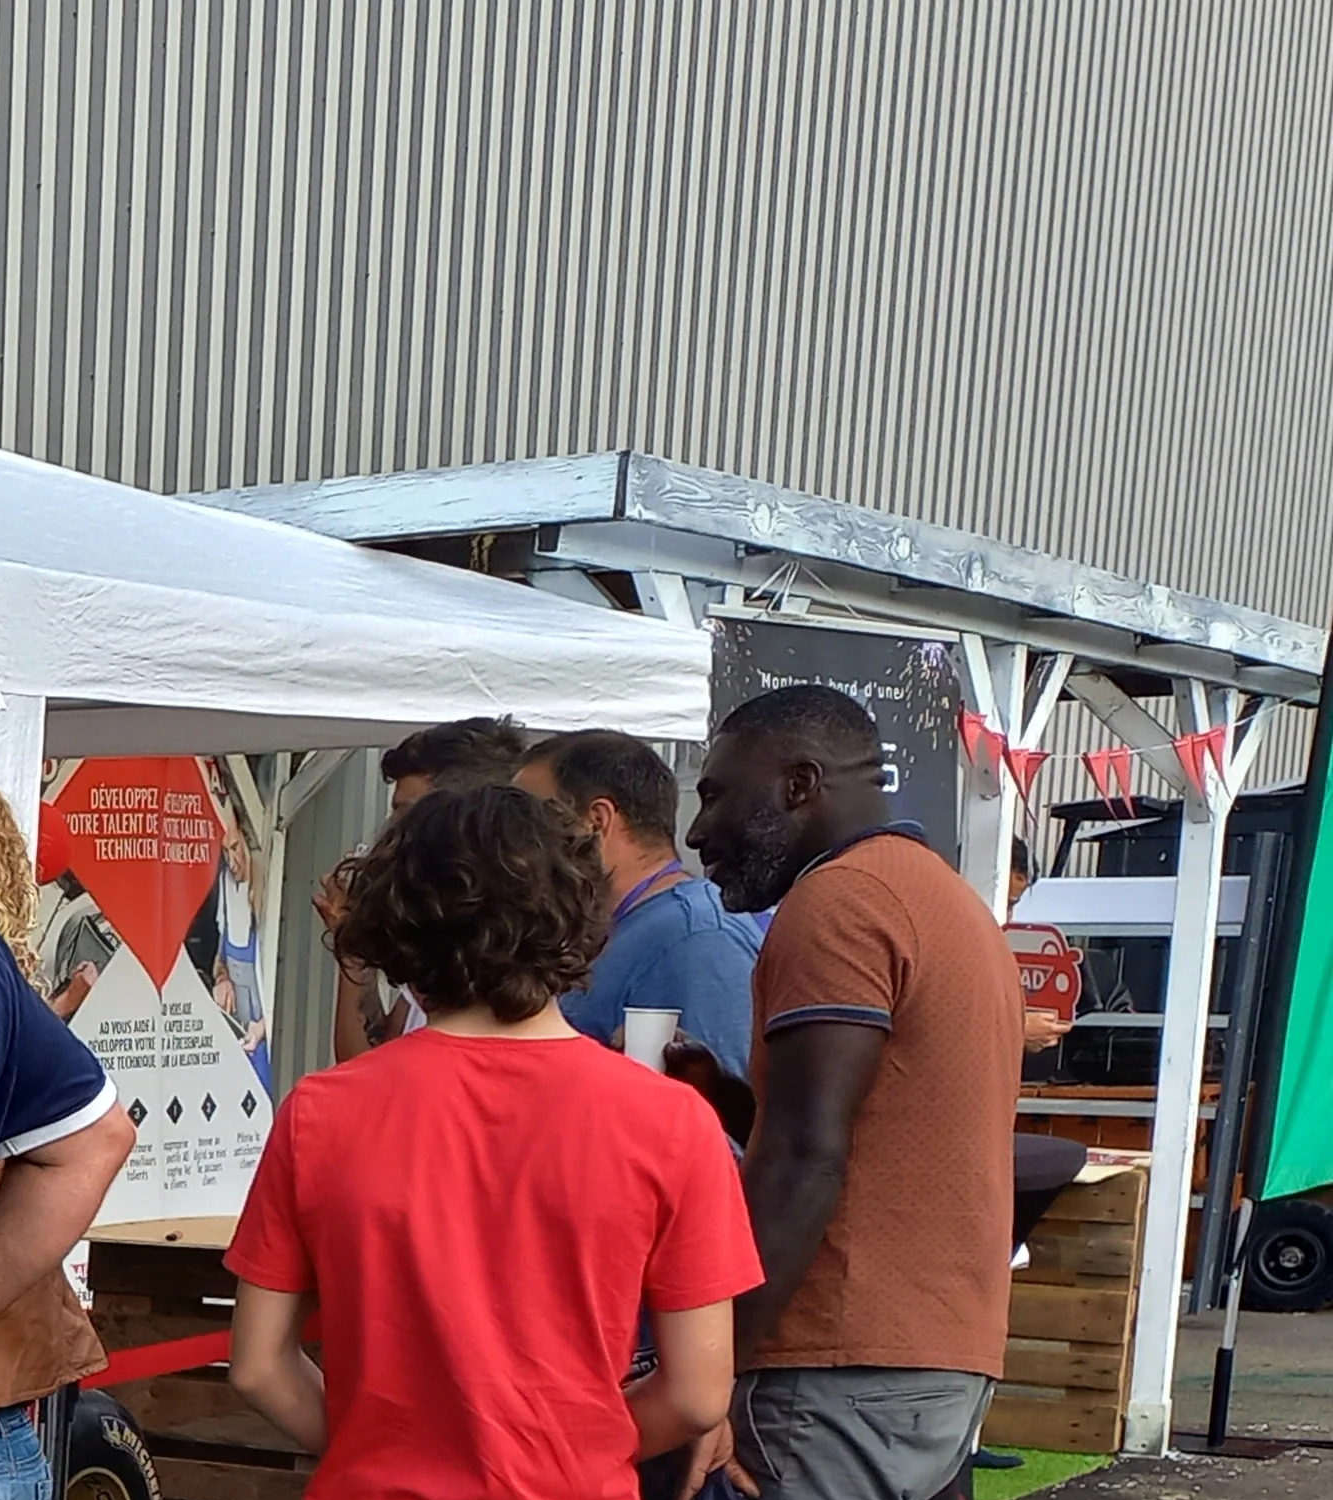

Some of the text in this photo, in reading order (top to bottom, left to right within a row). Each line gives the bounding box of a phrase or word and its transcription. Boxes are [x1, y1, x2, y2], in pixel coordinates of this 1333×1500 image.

[90, 781, 159, 810] DÉVELOPPEZ
[102, 812, 144, 836] TALENT
[146, 812, 159, 835] DE
[94, 838, 159, 861] TECHNICIEN
[1020, 969, 1046, 992] AD
[111, 1020, 132, 1035] VOUS
